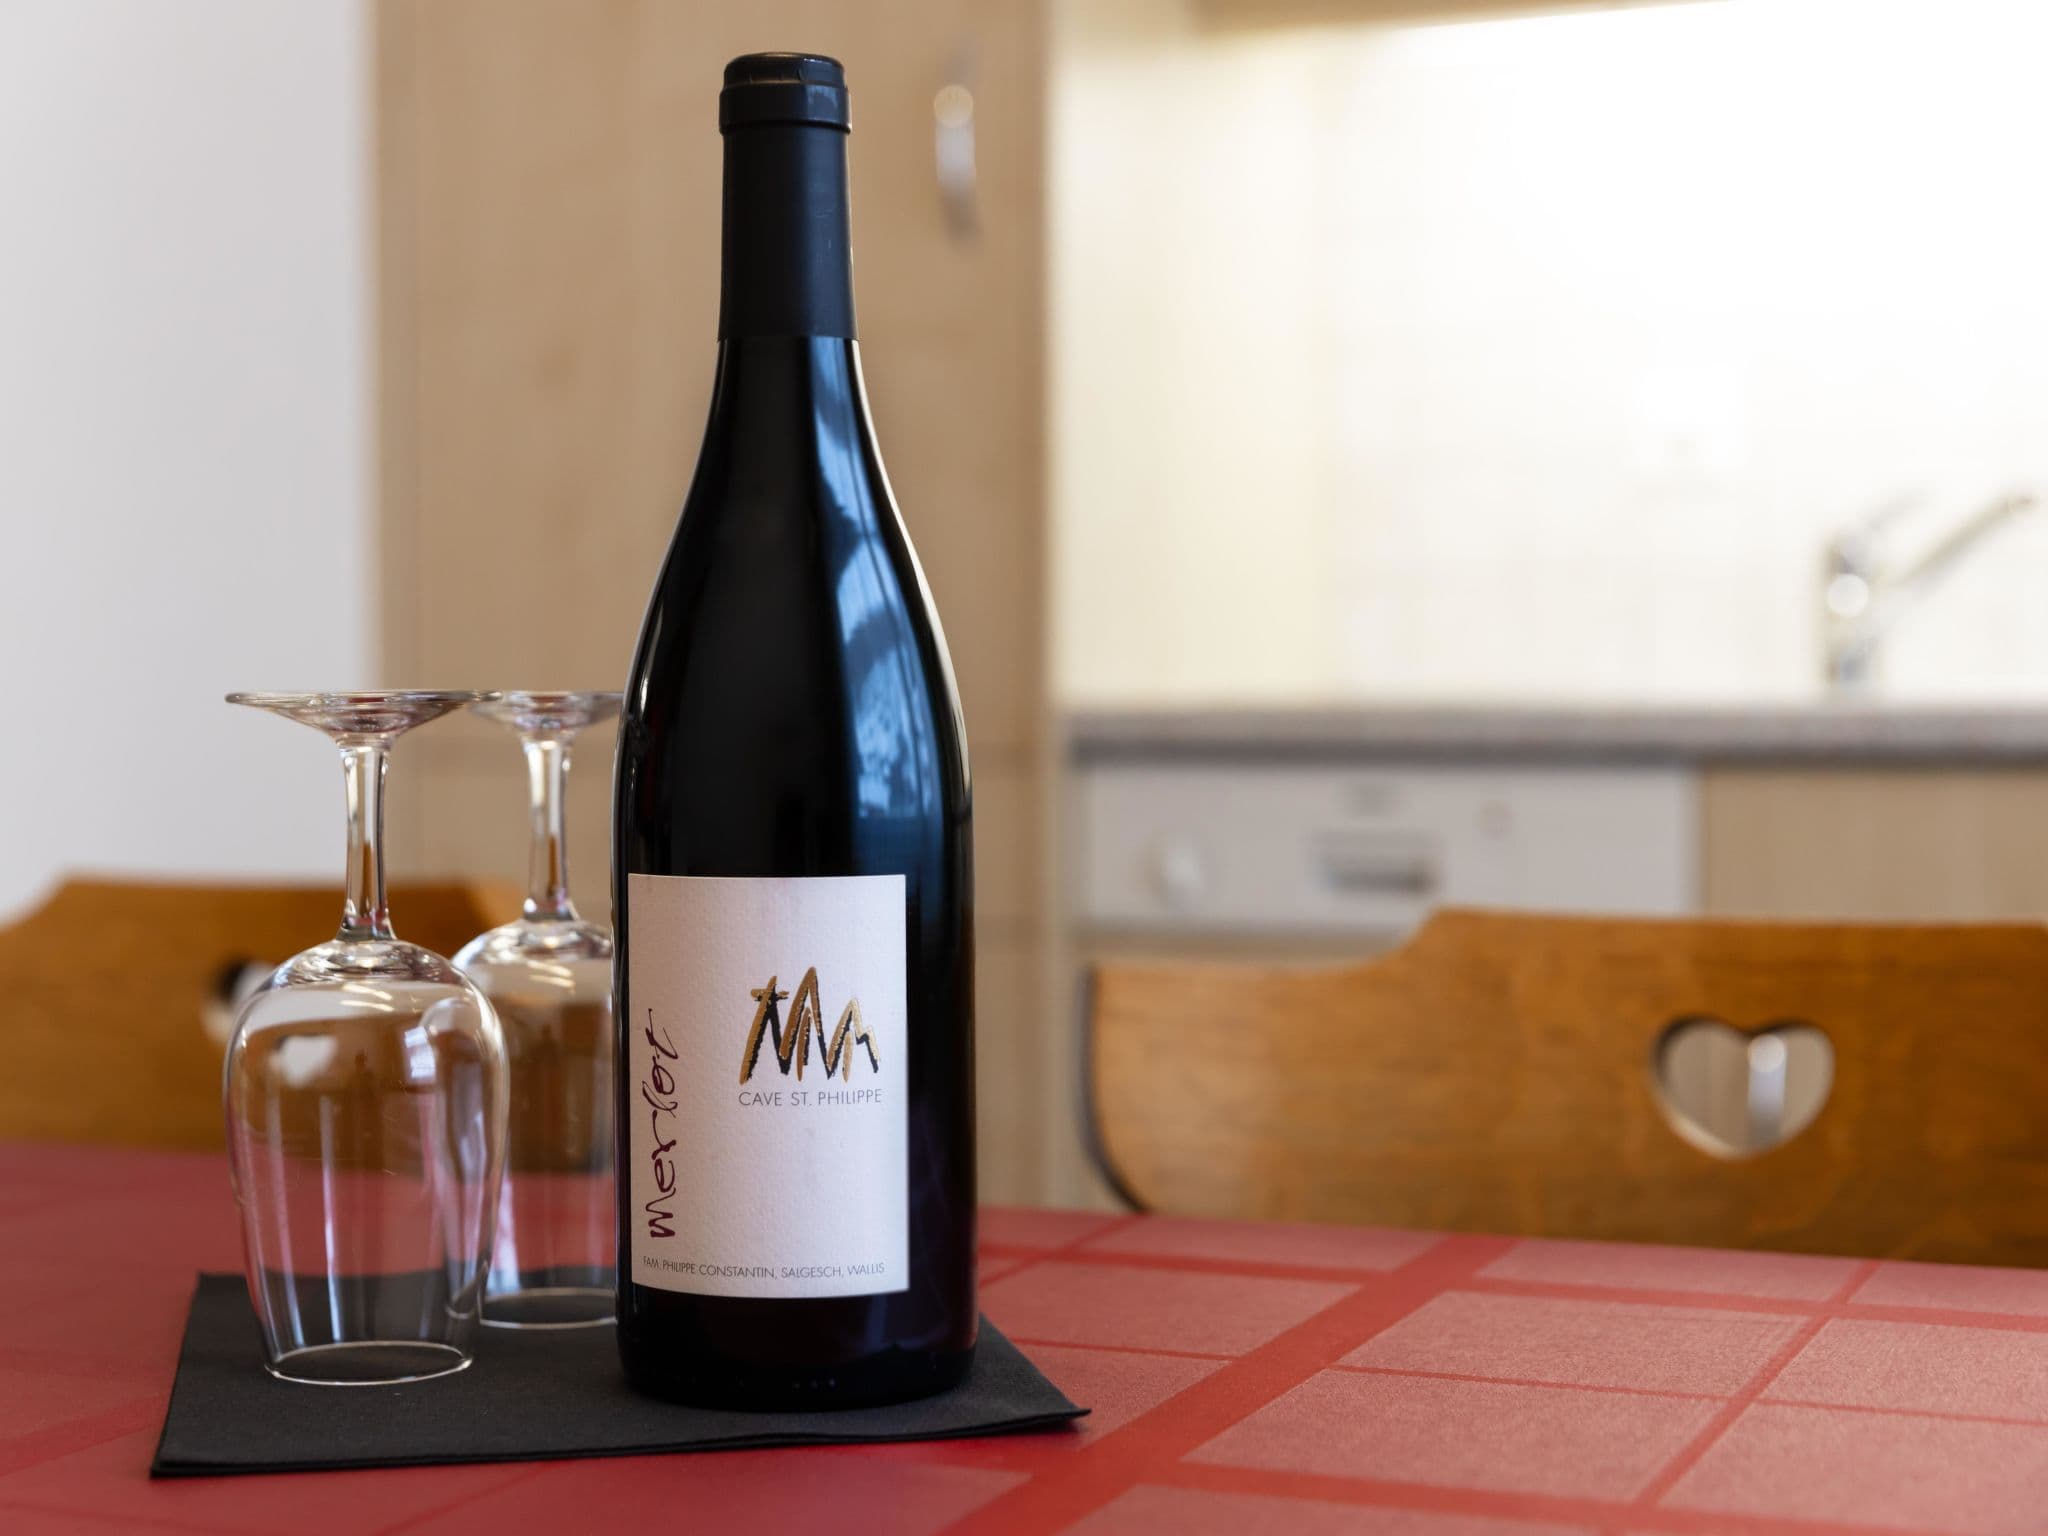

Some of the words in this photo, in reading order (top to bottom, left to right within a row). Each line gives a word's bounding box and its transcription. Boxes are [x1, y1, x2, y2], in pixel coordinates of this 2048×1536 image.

[738, 1091, 783, 1106] CAVE
[790, 1091, 812, 1106] ST.
[818, 1088, 882, 1105] PHILIPPE
[662, 1260, 697, 1275] PHILIPPE
[699, 1264, 778, 1280] CONSTANTIN,
[781, 1265, 844, 1279] SALGESCH,
[847, 1262, 885, 1276] WALLIS
